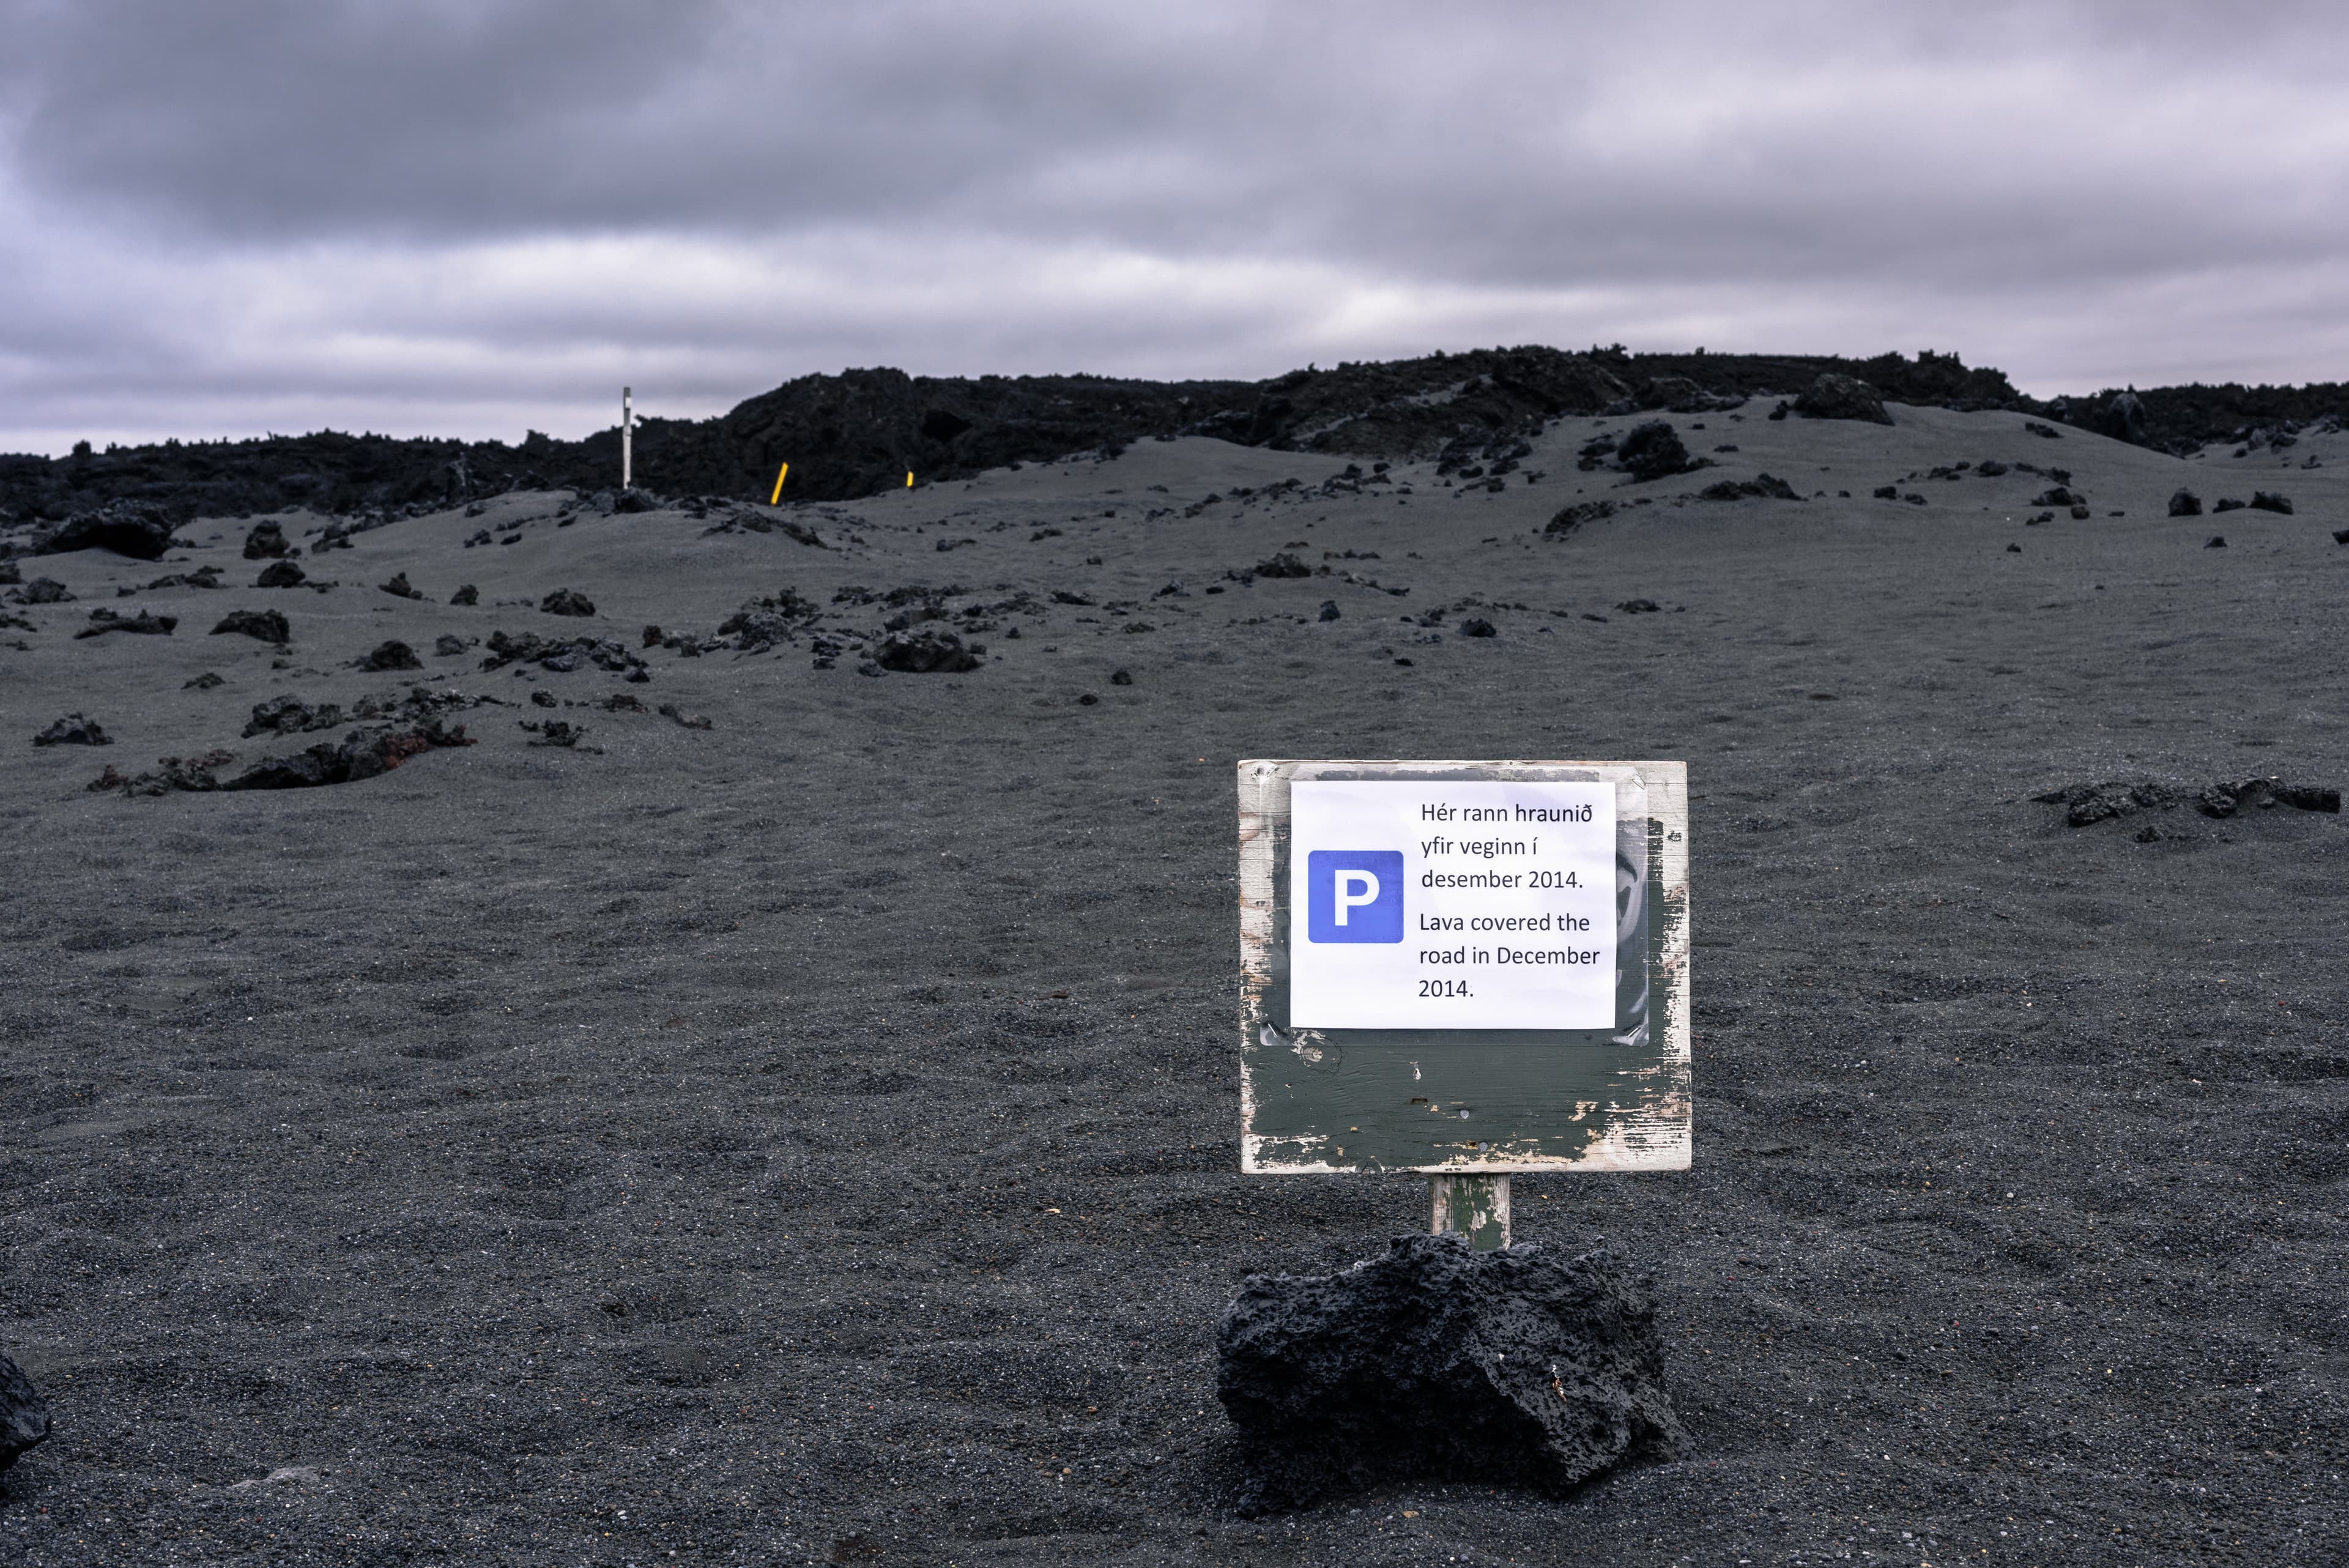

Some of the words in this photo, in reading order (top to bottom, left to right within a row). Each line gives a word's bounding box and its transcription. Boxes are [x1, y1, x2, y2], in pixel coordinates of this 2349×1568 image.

[1422, 803, 1457, 821] Hér
[1464, 808, 1508, 822] rann
[1516, 803, 1592, 822] hraunið
[1421, 836, 1454, 858] yfir
[1460, 838, 1525, 859] veginn
[1422, 869, 1522, 888] desember
[1529, 871, 1583, 888] 2014.
[1335, 869, 1380, 926] P
[1420, 913, 1463, 931] Lava
[1471, 913, 1550, 931] covered
[1557, 913, 1590, 931] the
[1420, 946, 1464, 964] road
[1472, 946, 1489, 964] in
[1497, 946, 1600, 965] December
[1419, 979, 1474, 997] 2014.
